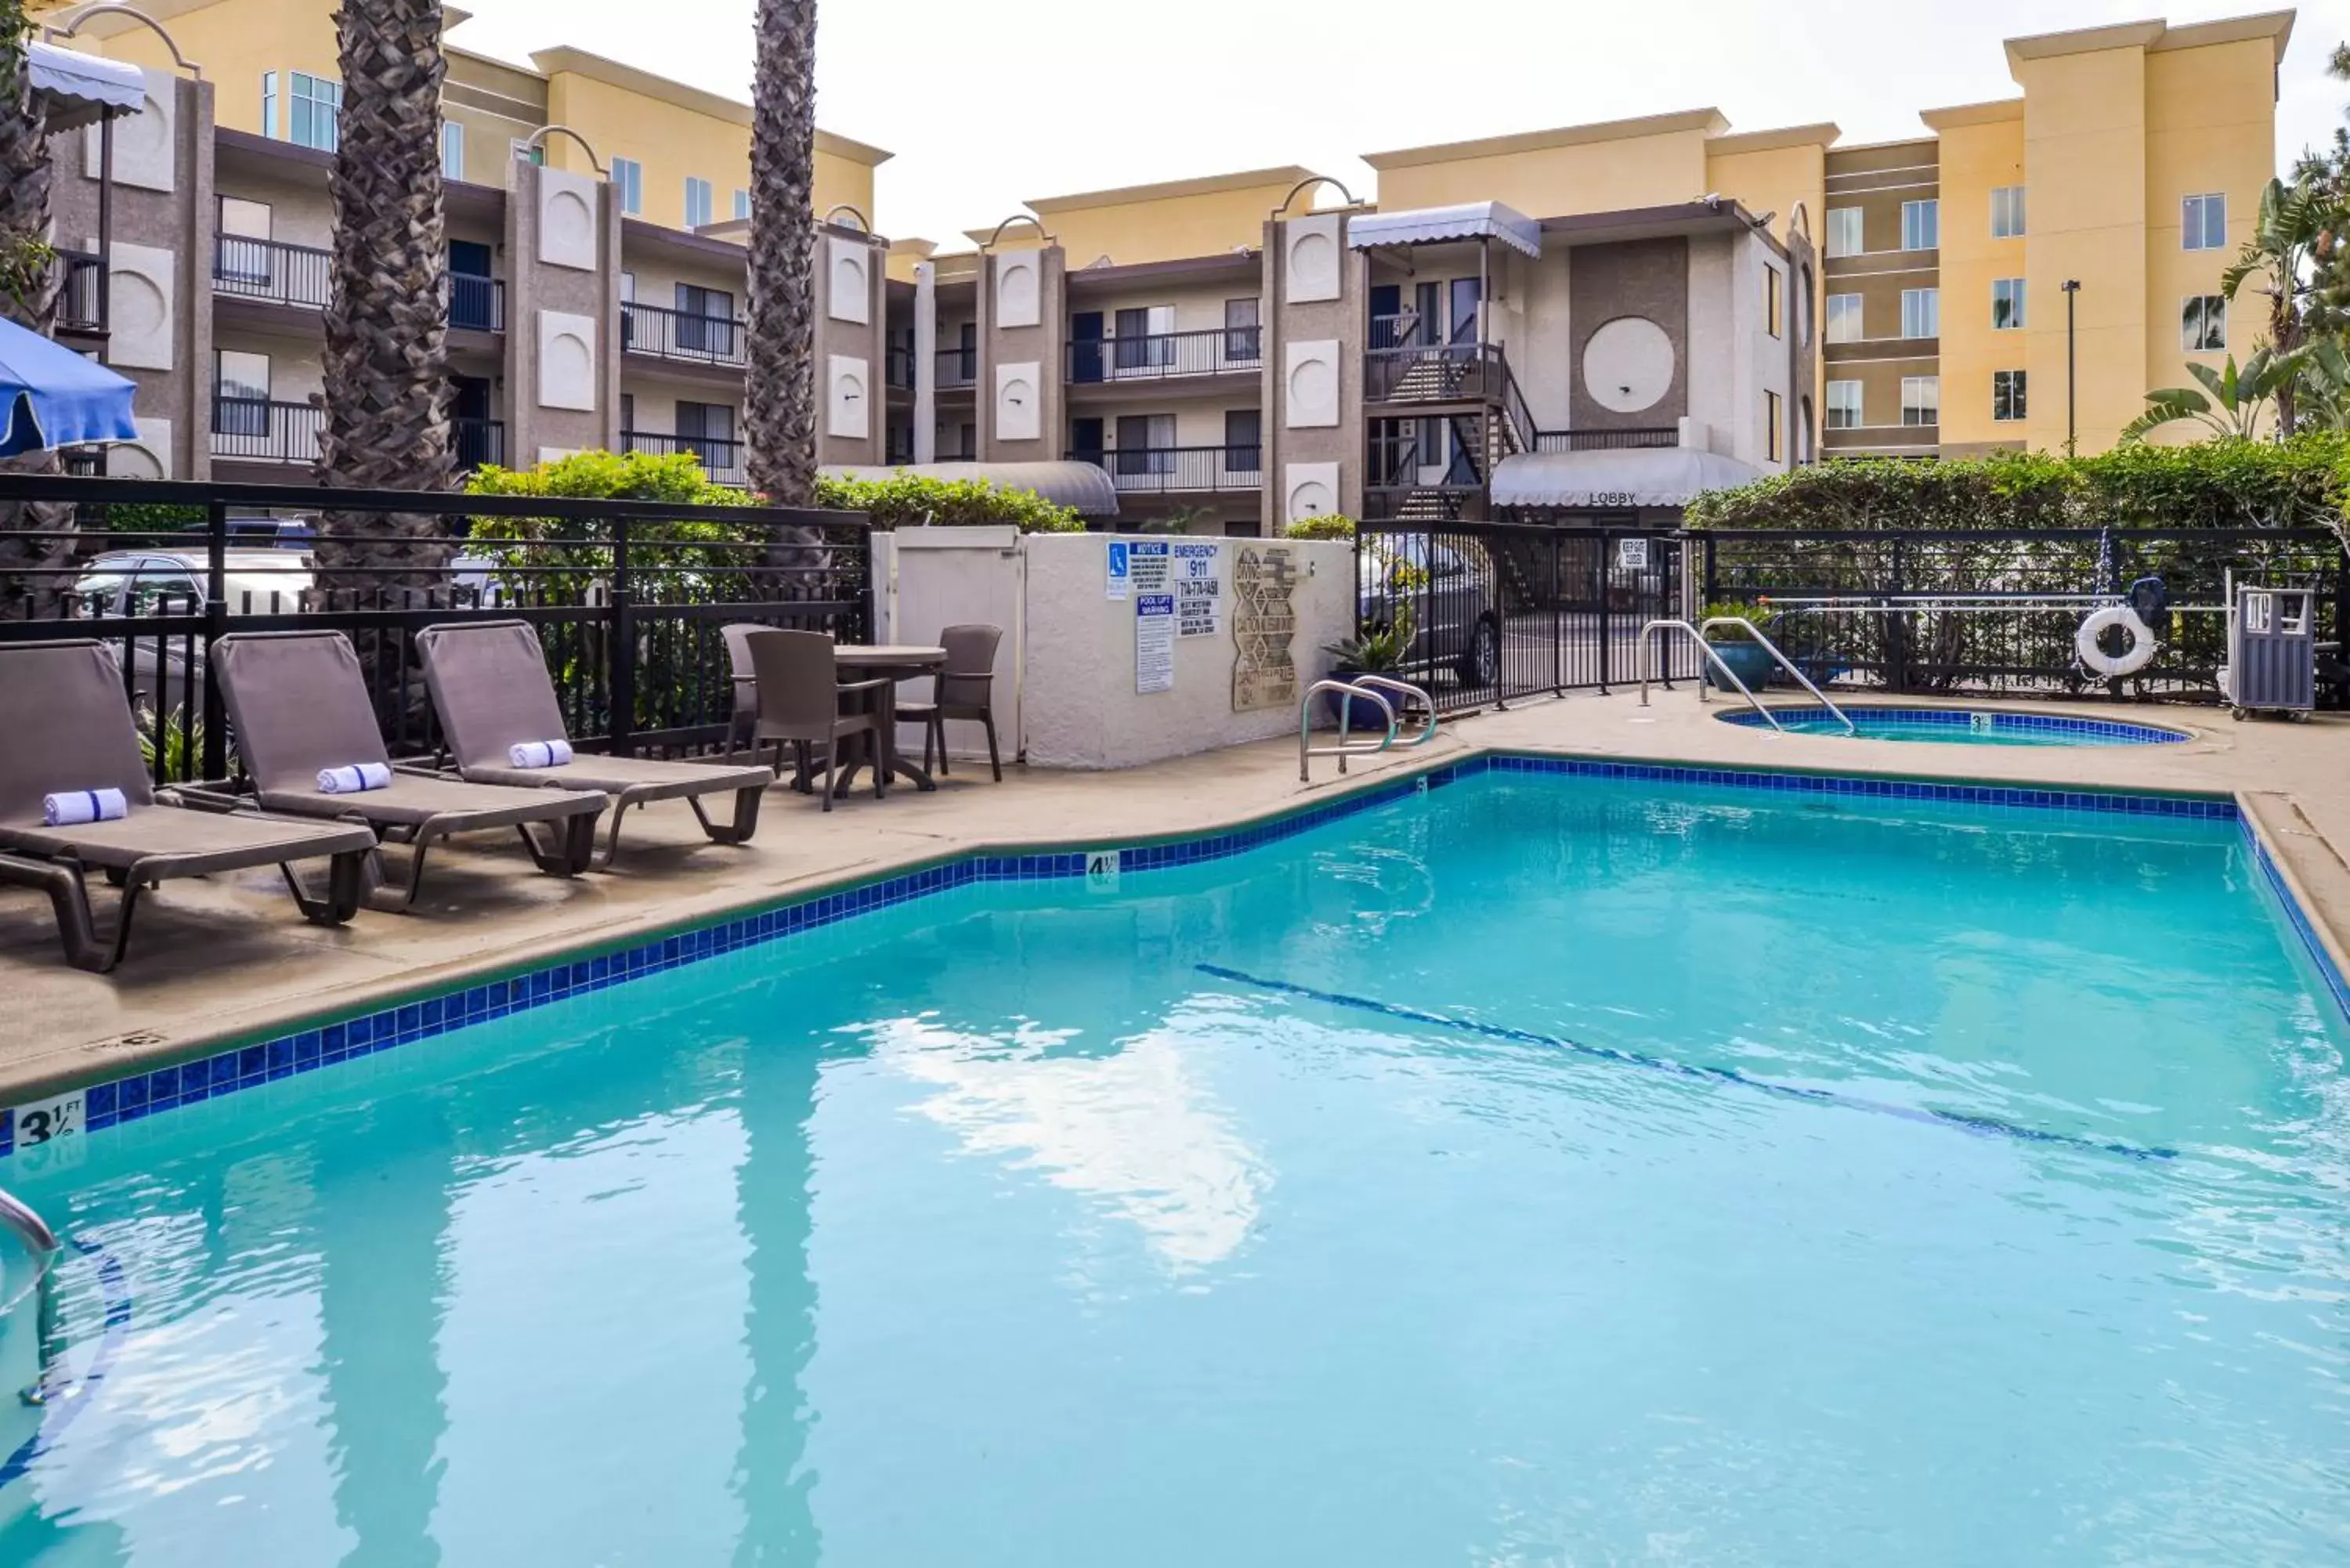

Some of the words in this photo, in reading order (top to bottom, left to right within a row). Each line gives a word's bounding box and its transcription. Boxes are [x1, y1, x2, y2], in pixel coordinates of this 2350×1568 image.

[1589, 492, 1636, 504] LOBBY
[1137, 543, 1161, 555] NOTICE
[1174, 544, 1218, 558] EMERGENCY
[1190, 560, 1207, 577] 911
[66, 1099, 82, 1113] FT
